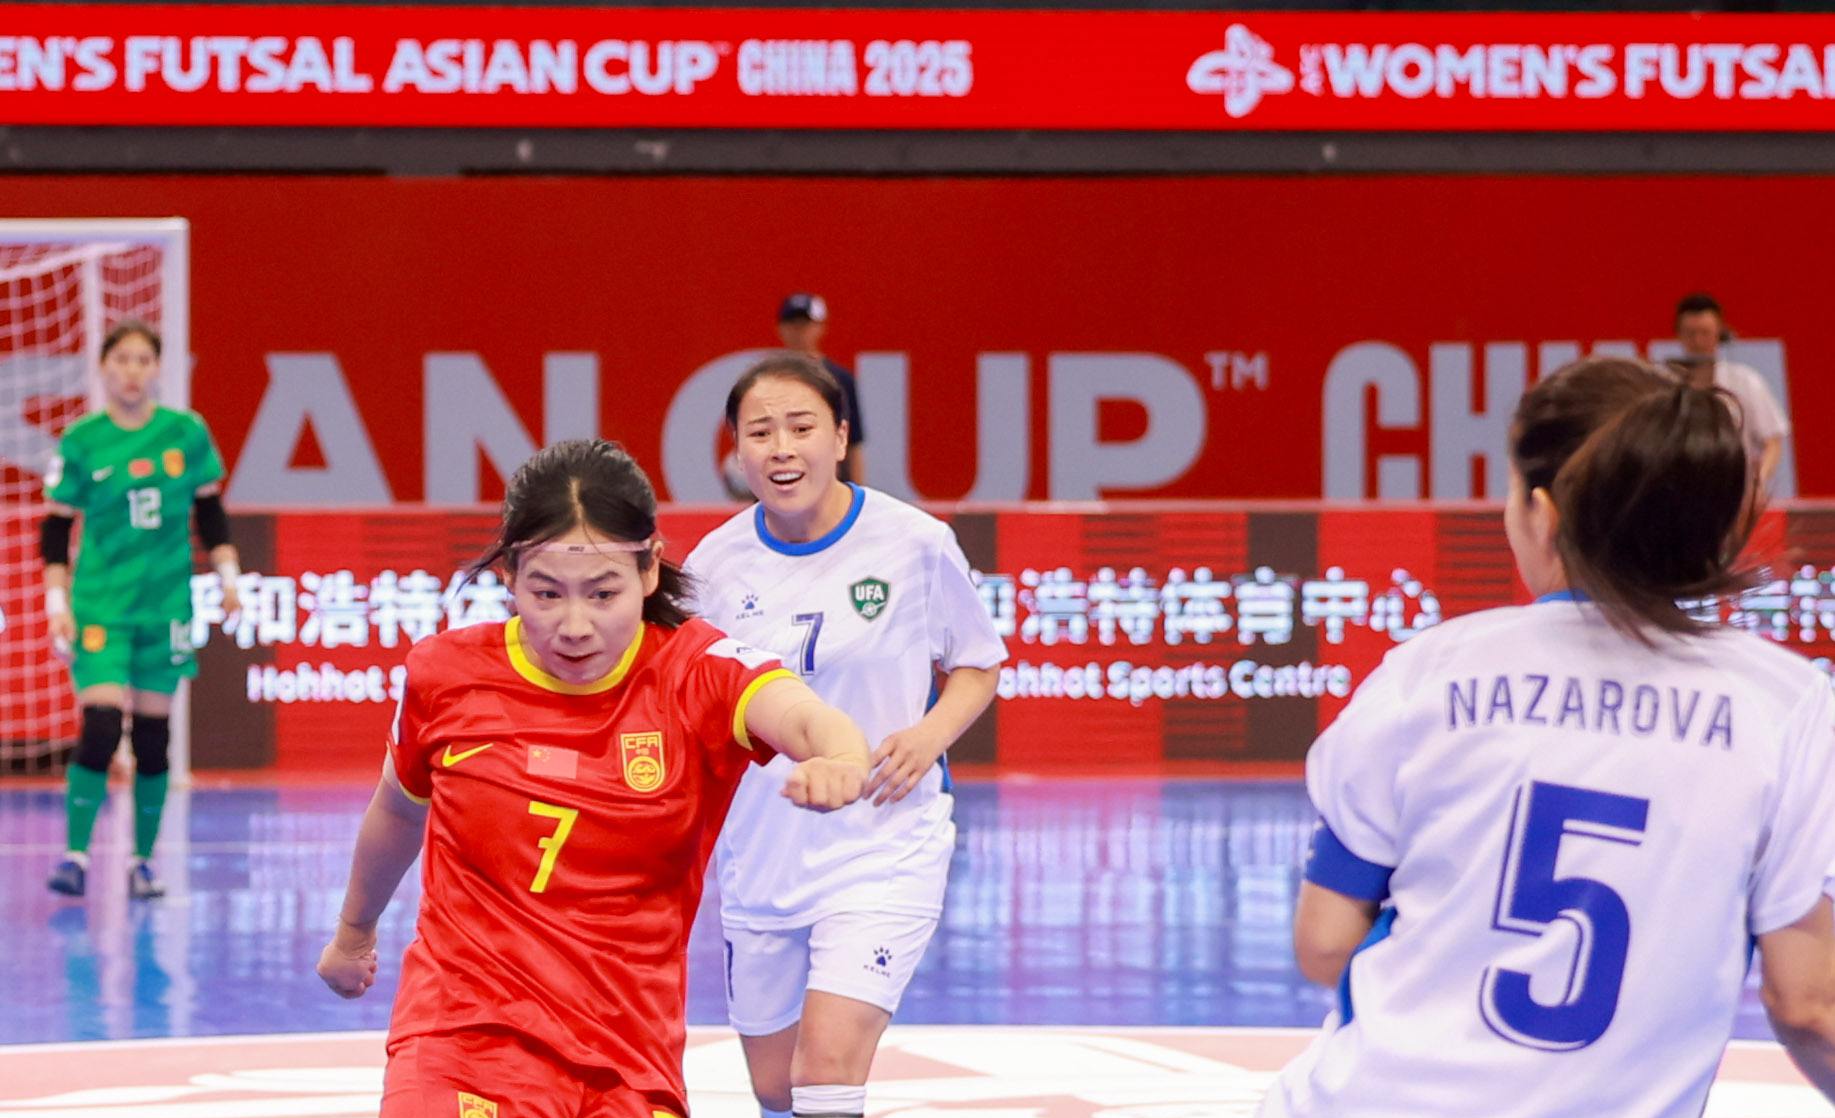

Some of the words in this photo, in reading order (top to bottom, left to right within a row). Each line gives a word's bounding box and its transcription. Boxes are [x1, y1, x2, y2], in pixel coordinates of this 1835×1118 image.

[125, 36, 373, 92] FUTSAL
[383, 39, 577, 94] ASIAN
[738, 40, 857, 96] CHINA
[864, 41, 973, 96] 2025
[1321, 43, 1616, 98] WOMEN'S
[127, 487, 162, 529] 12
[855, 584, 884, 601] UFA
[791, 611, 824, 677] 7
[247, 661, 387, 703] Hohhot
[998, 661, 1105, 699] ohhot
[1106, 661, 1228, 706] Sports
[1229, 660, 1351, 699] Centre
[1447, 674, 1734, 751] NAZAROVA
[625, 736, 659, 749] CFA
[528, 800, 579, 893] 7
[1479, 780, 1650, 1054] 5
